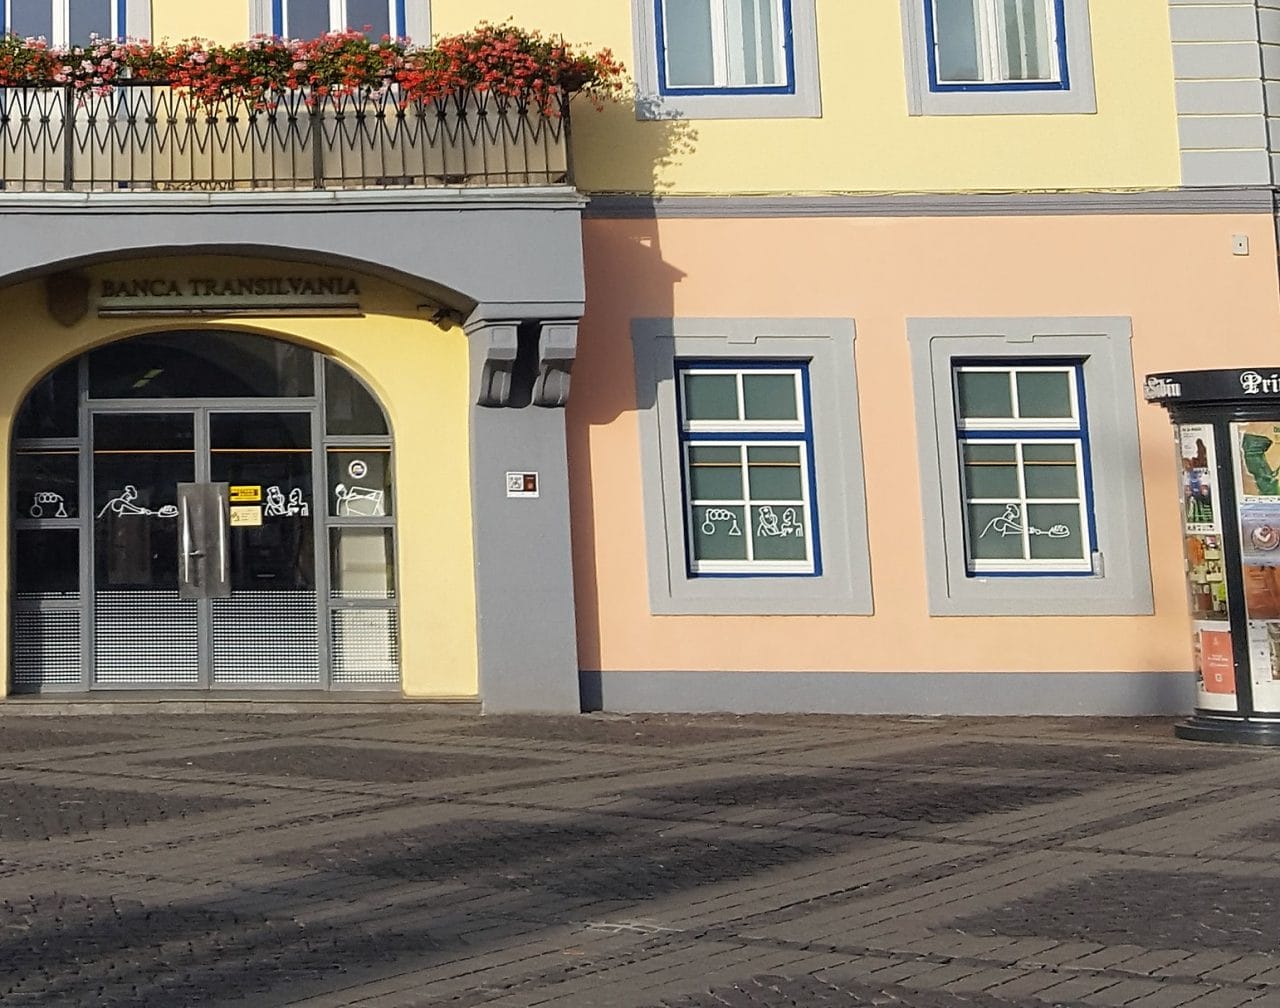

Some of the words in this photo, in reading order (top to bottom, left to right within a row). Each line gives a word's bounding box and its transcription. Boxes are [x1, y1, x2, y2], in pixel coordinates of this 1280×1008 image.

[101, 278, 183, 297] BANCA
[188, 277, 360, 296] TRANSILVANIA
[1239, 370, 1280, 394] Pri
